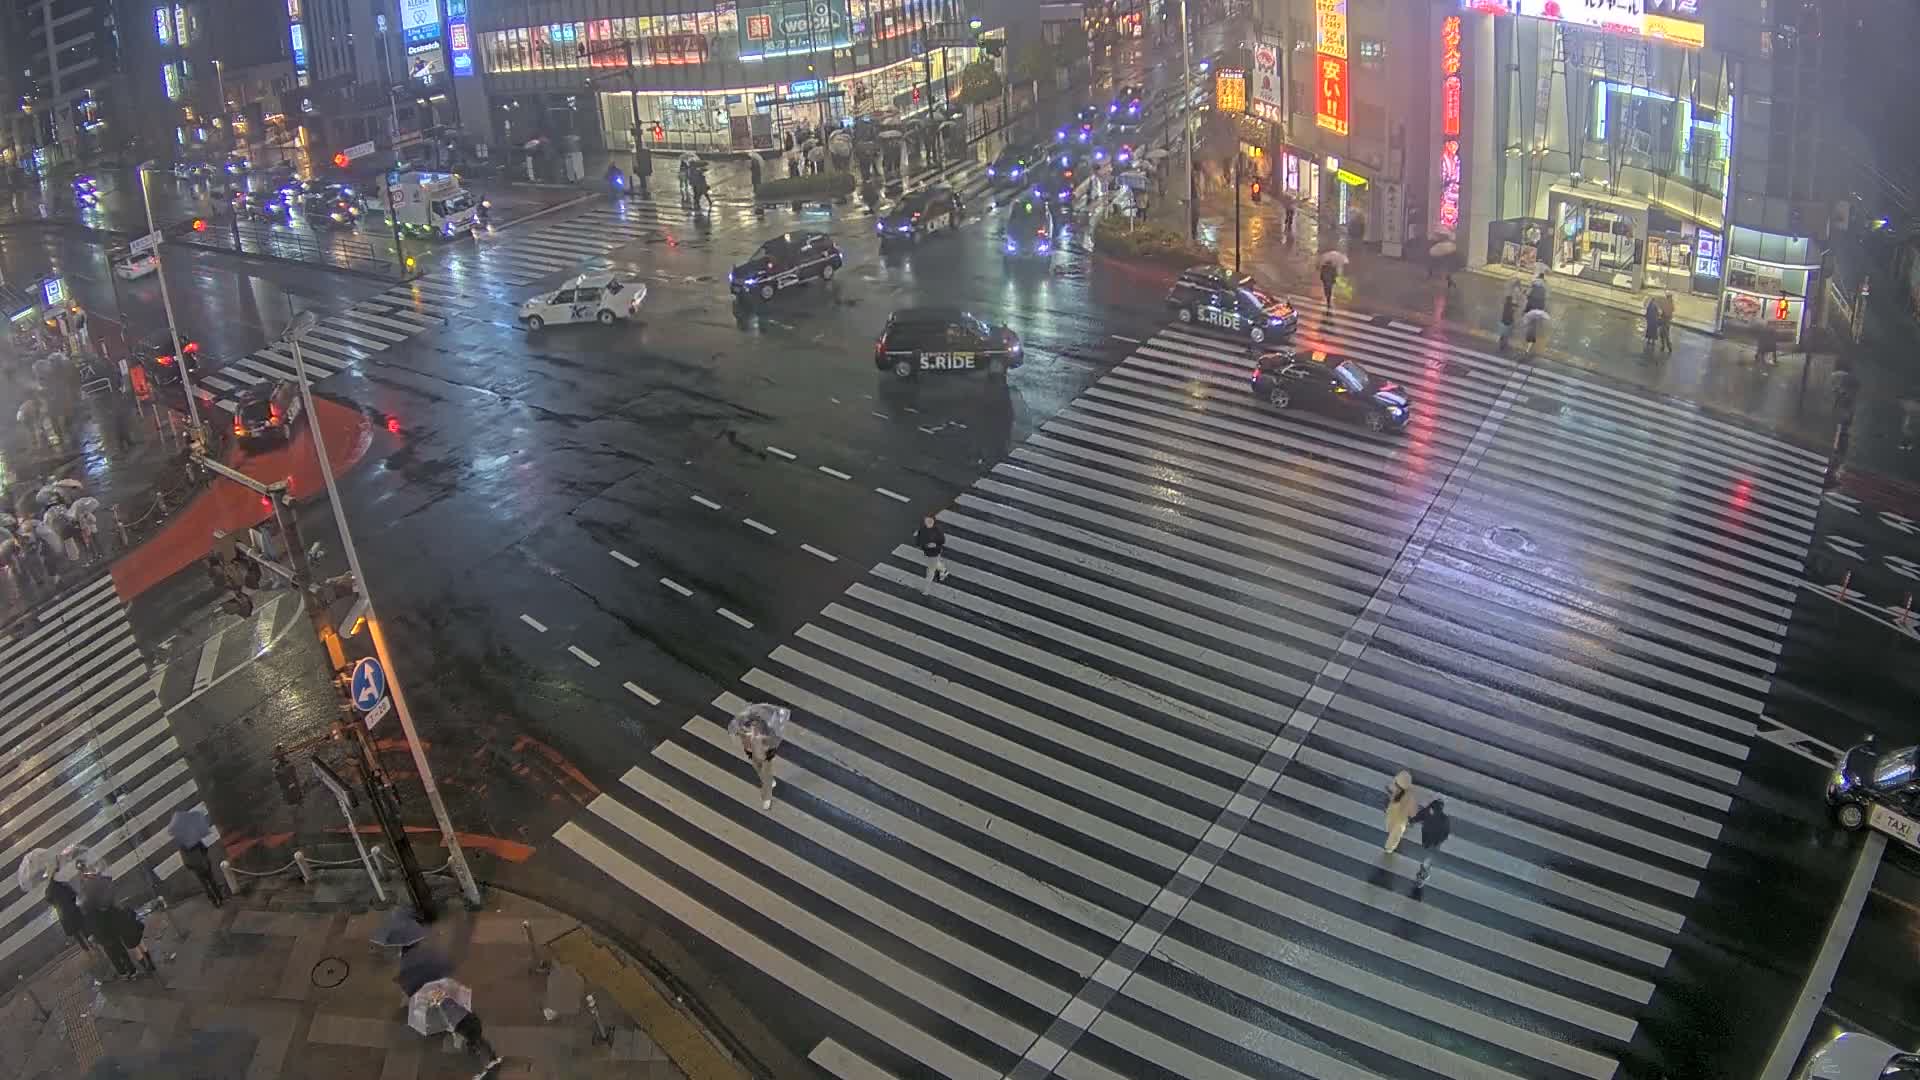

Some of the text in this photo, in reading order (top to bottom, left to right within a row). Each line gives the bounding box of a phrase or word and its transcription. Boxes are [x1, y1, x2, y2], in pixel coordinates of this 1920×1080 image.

[1197, 305, 1241, 331] S.RIDE
[920, 355, 976, 369] S.RIDE
[1887, 815, 1911, 834] TAXI
